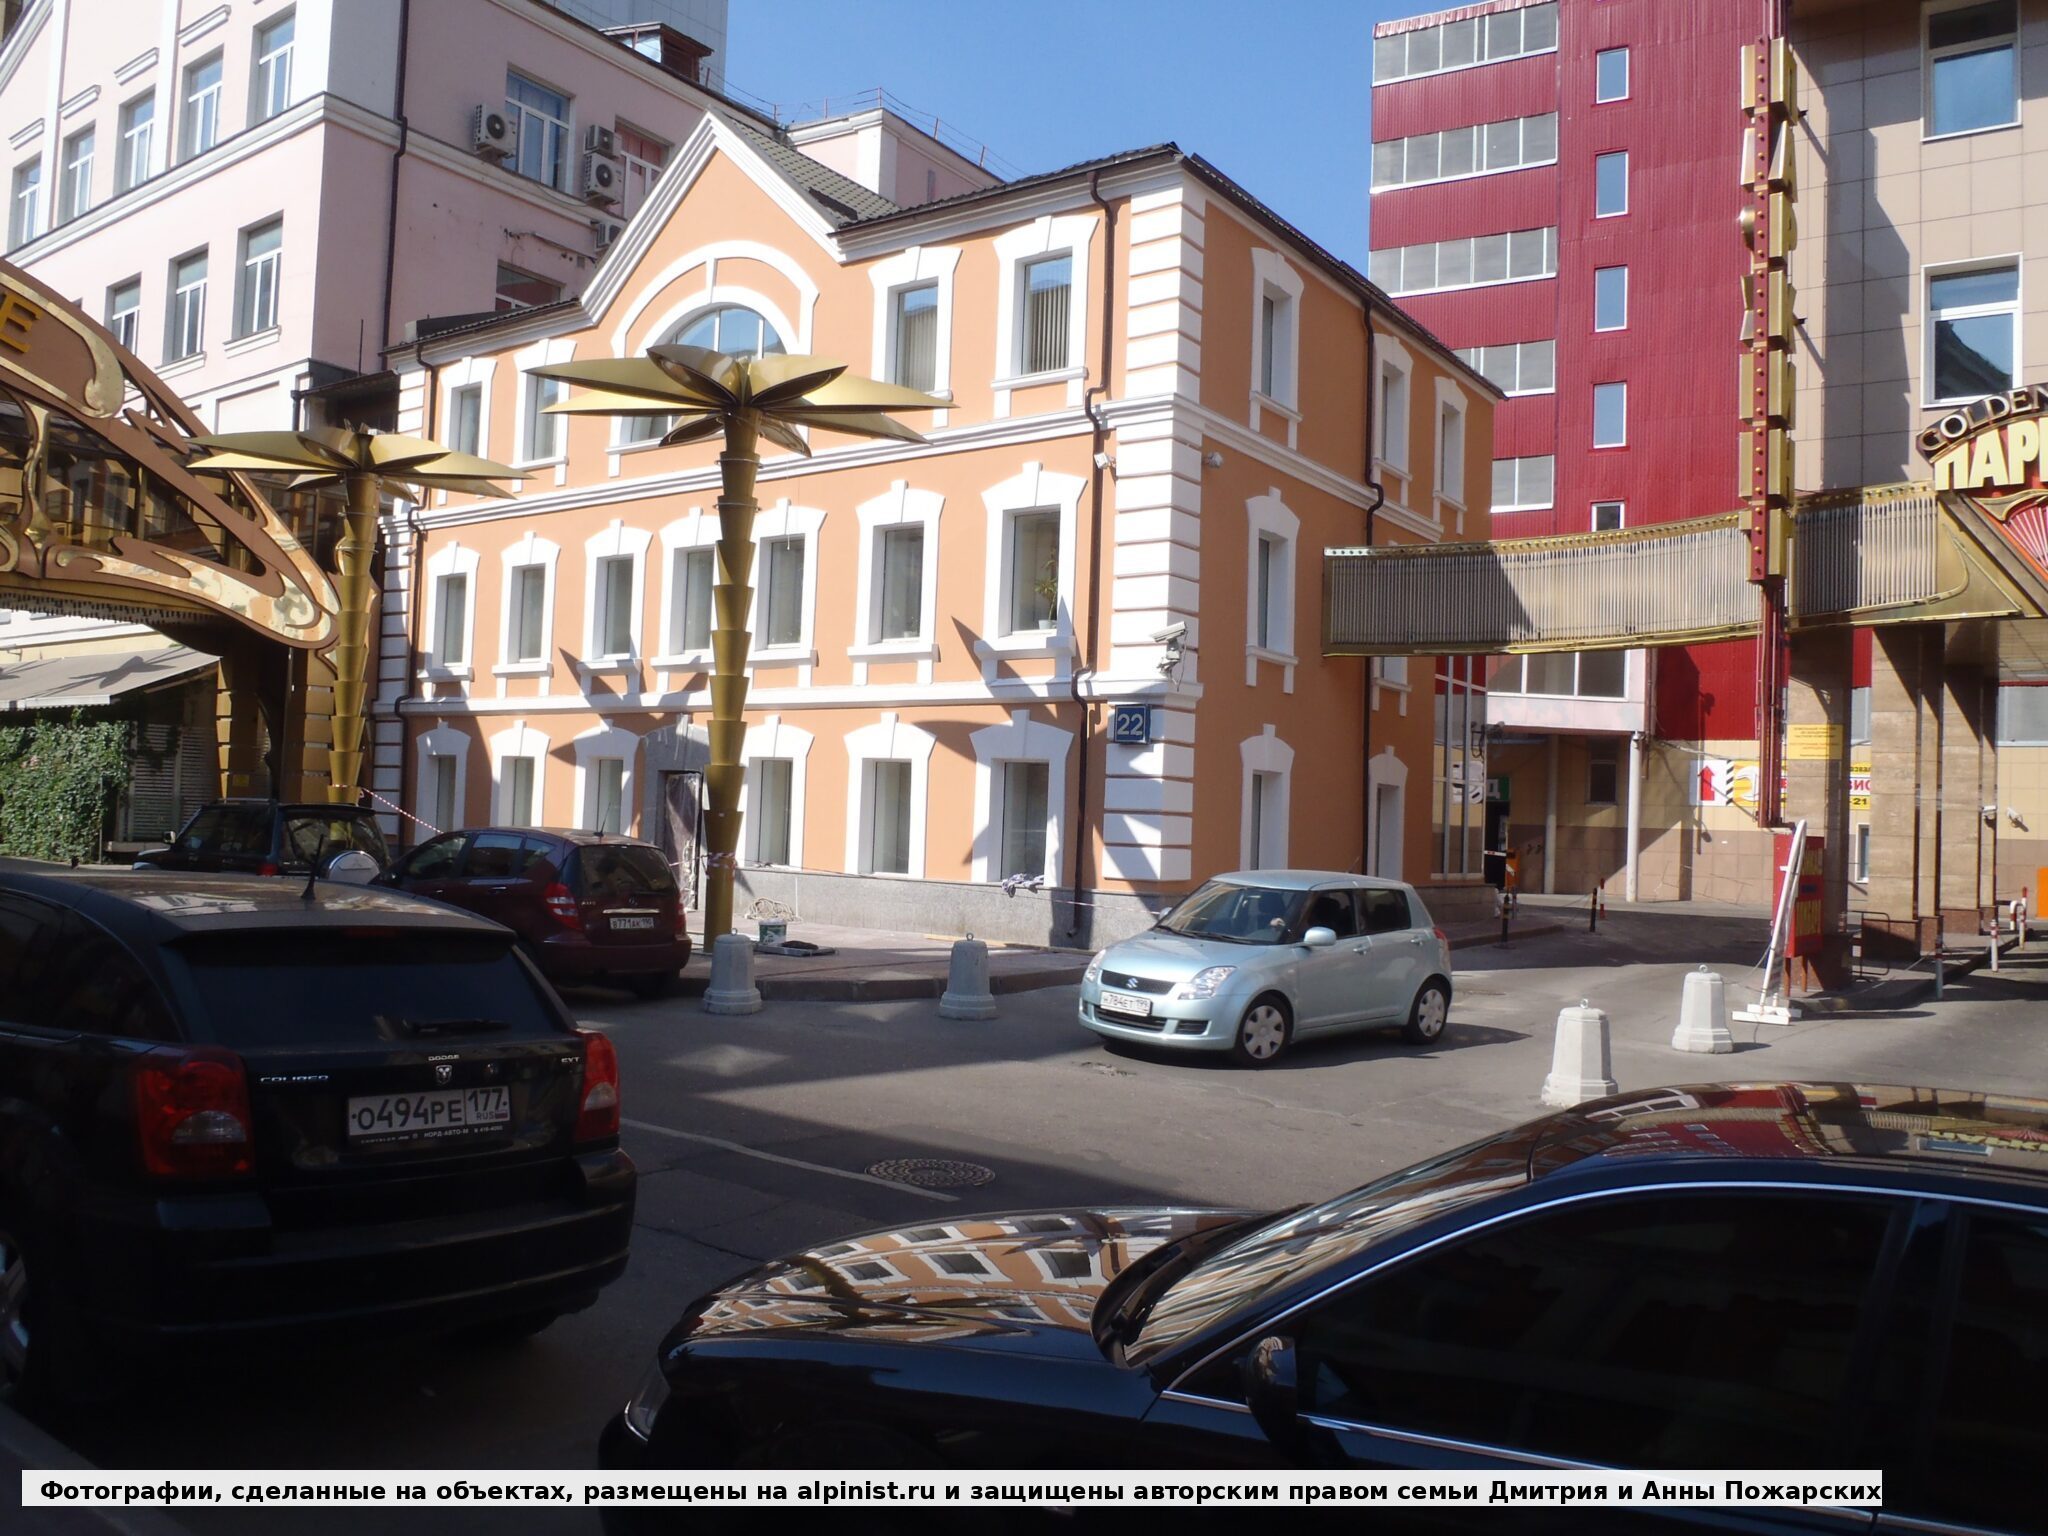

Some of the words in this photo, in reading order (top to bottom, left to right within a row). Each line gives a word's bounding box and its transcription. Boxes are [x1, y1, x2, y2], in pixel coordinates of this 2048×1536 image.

[1117, 713, 1143, 736] 22
[468, 1088, 503, 1112] 177
[476, 1111, 494, 1120] RUS
